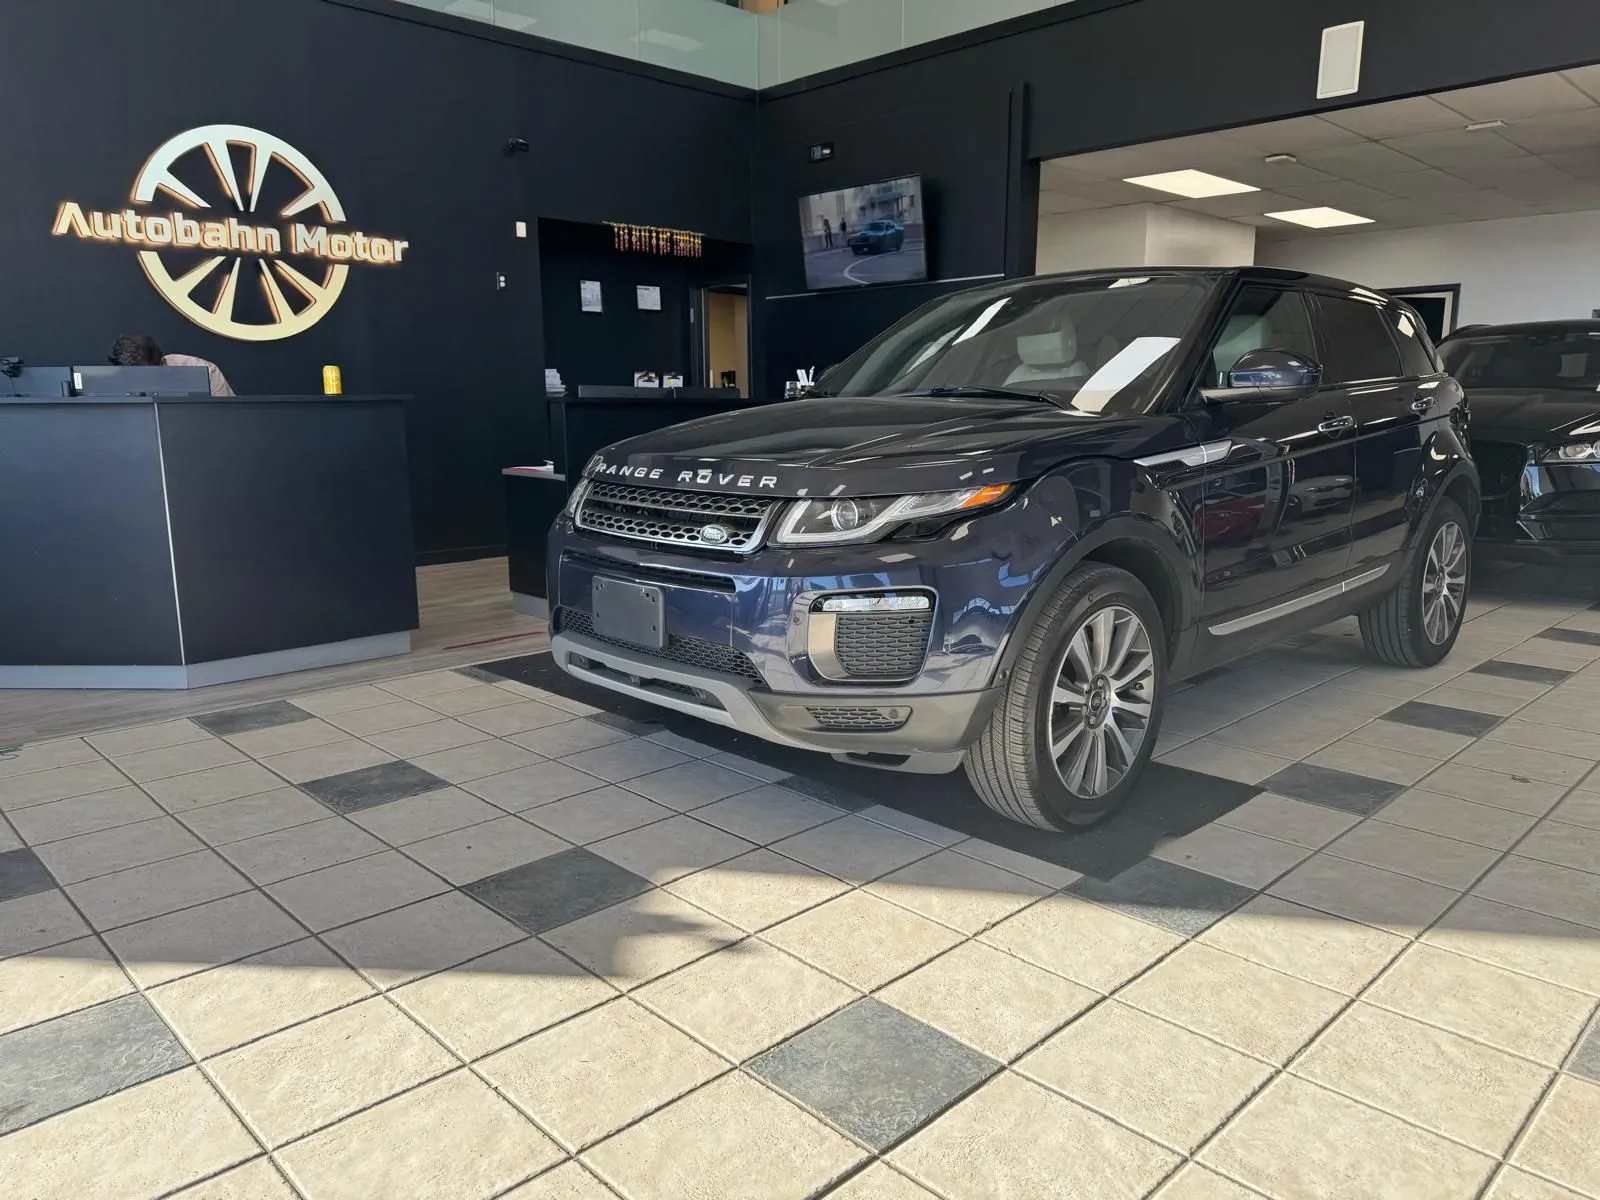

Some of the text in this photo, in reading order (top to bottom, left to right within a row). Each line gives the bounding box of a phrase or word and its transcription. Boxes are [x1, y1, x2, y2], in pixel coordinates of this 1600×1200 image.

[53, 201, 408, 262] Autobahn Motor
[596, 463, 777, 488] RANGE ROVER
